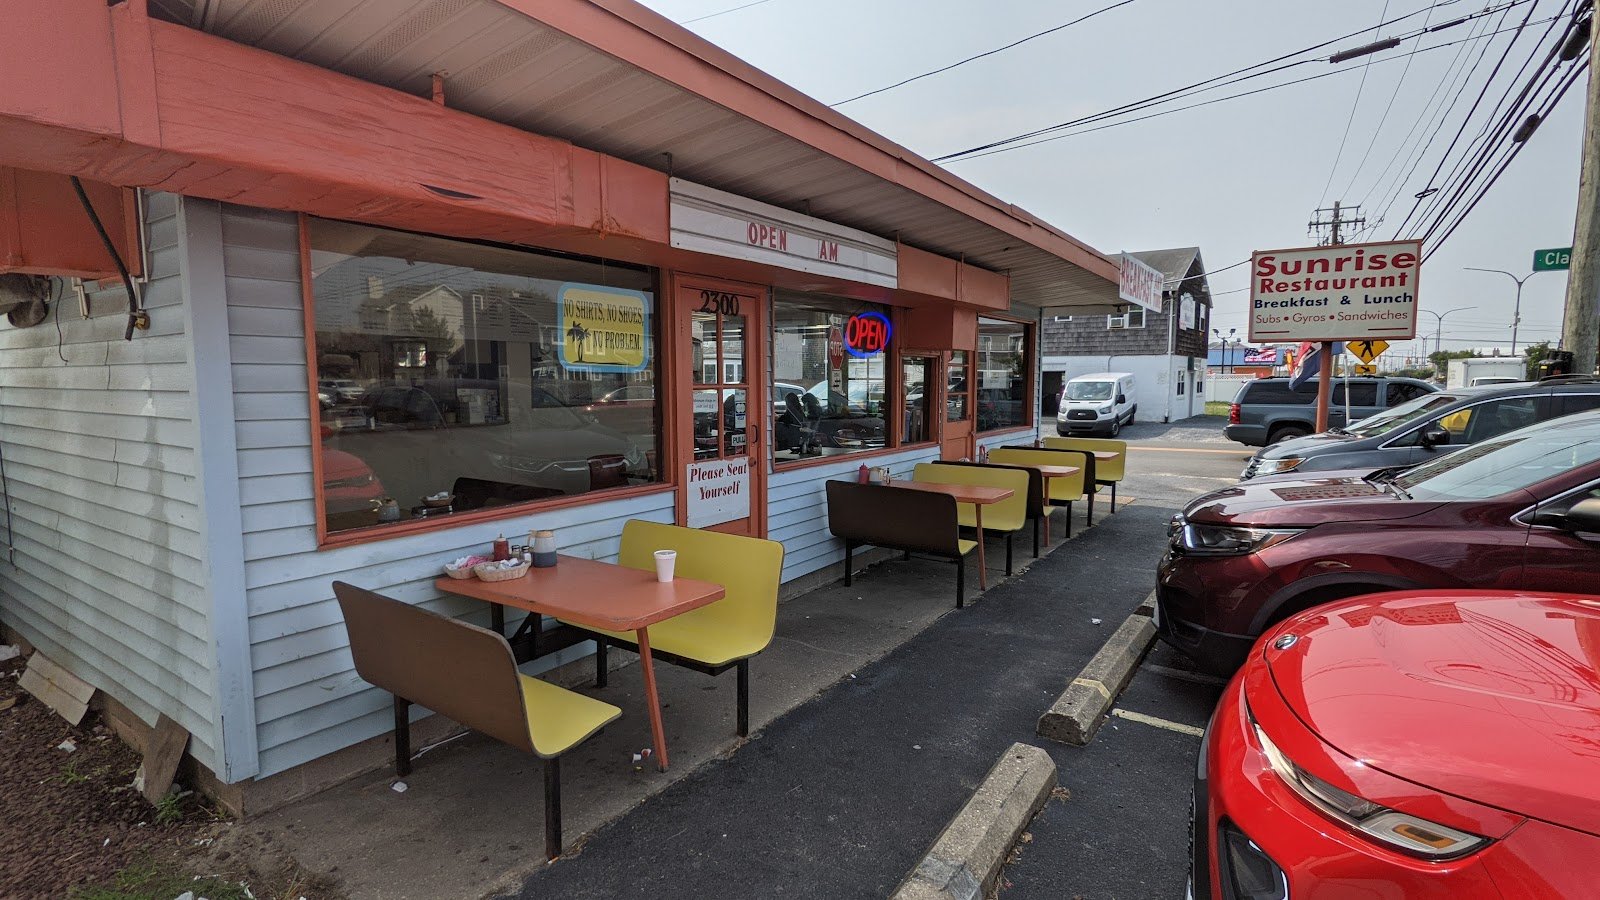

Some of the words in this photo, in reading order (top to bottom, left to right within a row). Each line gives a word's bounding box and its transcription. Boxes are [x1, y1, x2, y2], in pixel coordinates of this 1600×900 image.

[748, 222, 787, 251] OPEN
[819, 240, 838, 262] AM
[1256, 249, 1416, 277] Sunrise
[1260, 272, 1408, 294] Restaurant
[700, 290, 740, 316] 2300
[1254, 297, 1329, 309] Breakfast
[1340, 295, 1351, 305] &
[1364, 292, 1413, 304] Lunch
[563, 299, 574, 317] NO
[576, 301, 605, 323] SHIRTS,
[606, 303, 617, 322] NO
[618, 305, 644, 326] SHOES,
[1255, 314, 1281, 324] Subs
[1292, 312, 1326, 325] Gyros
[1337, 310, 1408, 322] Sandwiches
[593, 330, 604, 348] NO
[605, 331, 642, 350] PROBLEM.
[847, 316, 887, 352] OPEN
[732, 436, 746, 444] PULL
[690, 467, 724, 482] Please
[726, 463, 747, 477] Seat
[699, 480, 741, 500] Yourself
